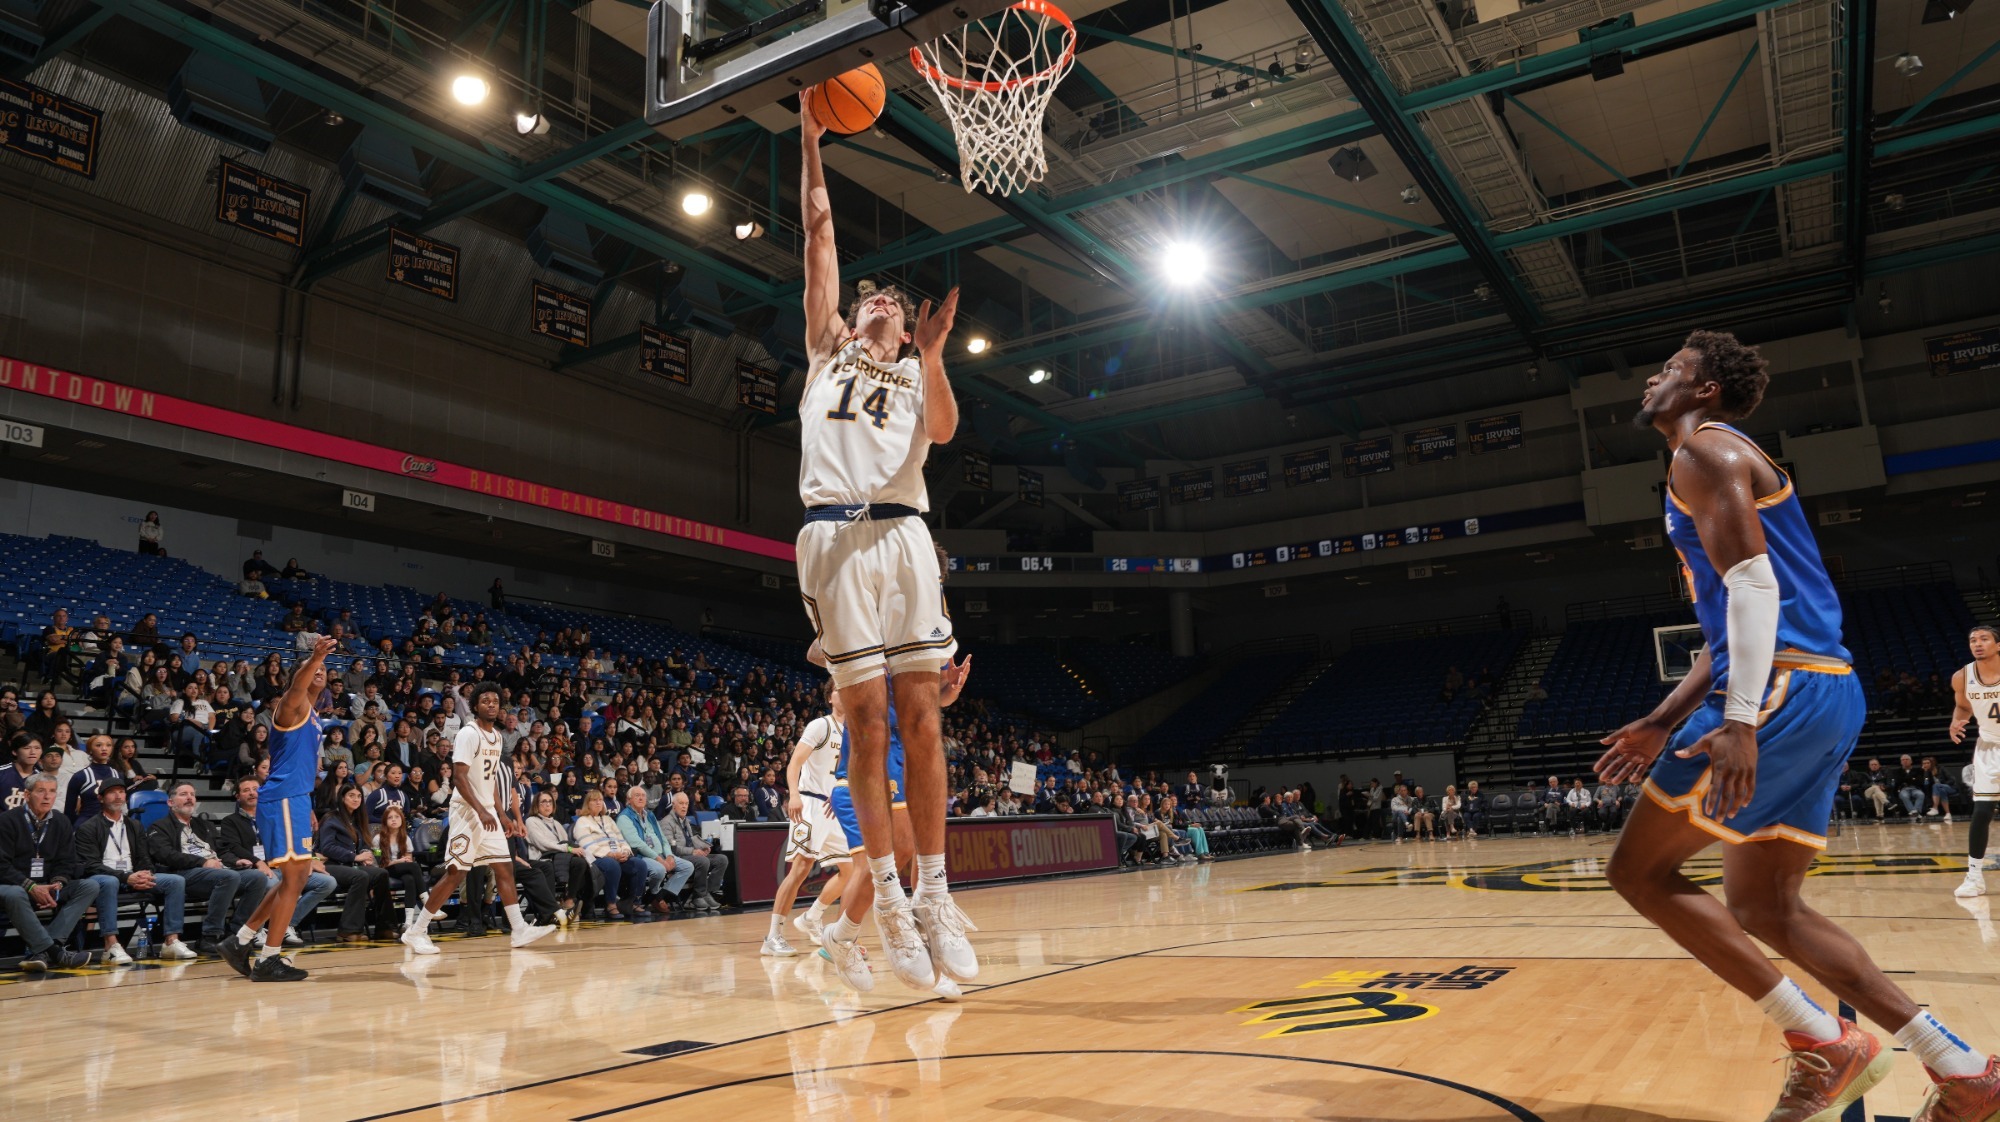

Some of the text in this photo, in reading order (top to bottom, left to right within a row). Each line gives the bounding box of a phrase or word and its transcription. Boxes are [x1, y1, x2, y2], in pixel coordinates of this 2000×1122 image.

[30, 91, 61, 111] 1971
[42, 107, 89, 132] CHAMPIONS
[25, 113, 88, 146] IRVINE
[26, 133, 86, 162] MEN'S TENNIS
[228, 175, 301, 208] NATIONAL CHAMPIONS
[256, 176, 278, 192] 1971
[226, 193, 300, 220] UC IRVINE
[415, 238, 433, 251] 1972
[392, 254, 452, 276] UC IRVINE
[422, 249, 453, 265] CHAMPIONS
[423, 275, 451, 289] SAILING
[536, 308, 587, 326] UC IRVINE
[643, 348, 686, 364] UC IRVINE
[1930, 351, 1950, 363] UC
[1952, 343, 2000, 360] IRVINE
[855, 358, 912, 388] IRVINE
[826, 374, 890, 430] 14
[5, 424, 33, 443] 103
[1470, 434, 1484, 443] UC
[1485, 427, 1521, 440] IRVINE
[1406, 444, 1420, 453] UC
[1421, 438, 1456, 451] IRVINE
[401, 454, 437, 474] Cane's
[1345, 457, 1359, 466] UC
[1360, 450, 1391, 463] IRVINE
[1239, 471, 1267, 483] IRVINE
[1284, 467, 1298, 477] UC
[1299, 461, 1330, 473] IRVINE
[1183, 481, 1213, 492] IRVINE
[349, 493, 368, 509] 104
[1131, 490, 1159, 502] IRVINE
[470, 470, 724, 546] RAISING CANE'S COUNTDOWN
[1827, 512, 1841, 522] 112
[1364, 539, 1374, 548] 14
[1406, 532, 1419, 541] 24
[596, 542, 611, 555] 105
[1321, 543, 1330, 553] 13
[977, 562, 991, 571] 1ST
[1021, 557, 1053, 570] 06.4
[1112, 558, 1128, 571] 26
[1414, 567, 1426, 577] 110
[1968, 692, 1980, 700] UC
[831, 741, 841, 750] UC
[484, 759, 498, 780] 24
[949, 826, 1103, 873] CANE'S COUNTDOWN
[1295, 970, 1388, 989] THE
[1420, 965, 1518, 989] WEST
